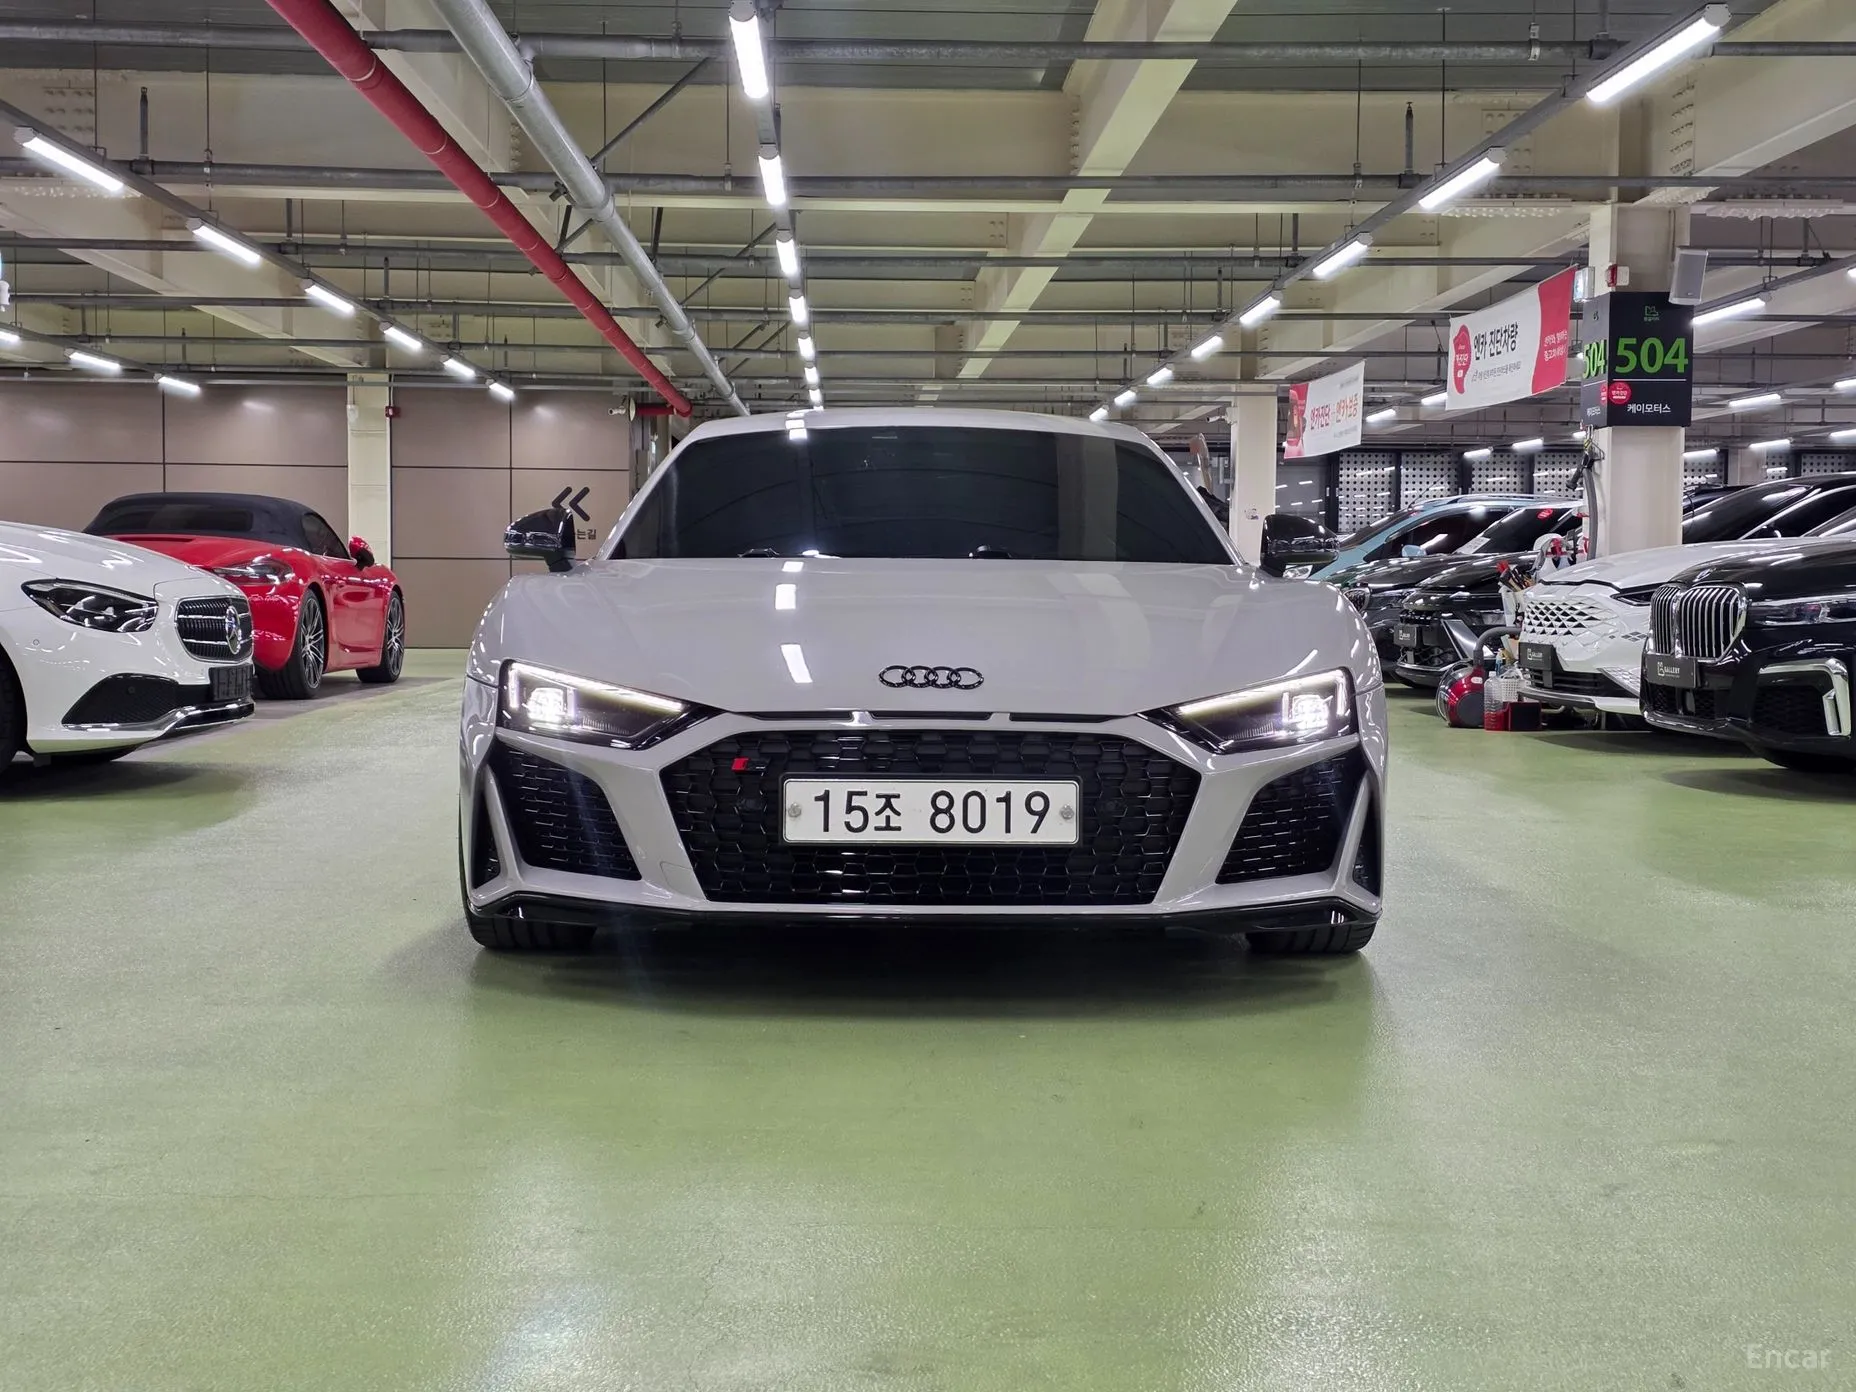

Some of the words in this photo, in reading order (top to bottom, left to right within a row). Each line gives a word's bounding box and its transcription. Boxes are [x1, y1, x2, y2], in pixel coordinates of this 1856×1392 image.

[1473, 331, 1488, 361] 엔카
[1488, 321, 1519, 358] 진단차량
[1582, 339, 1607, 379] 504
[1614, 337, 1689, 374] 504
[1627, 403, 1672, 414] 케이모터스
[813, 789, 902, 834] 15조
[929, 789, 1051, 835] 8019
